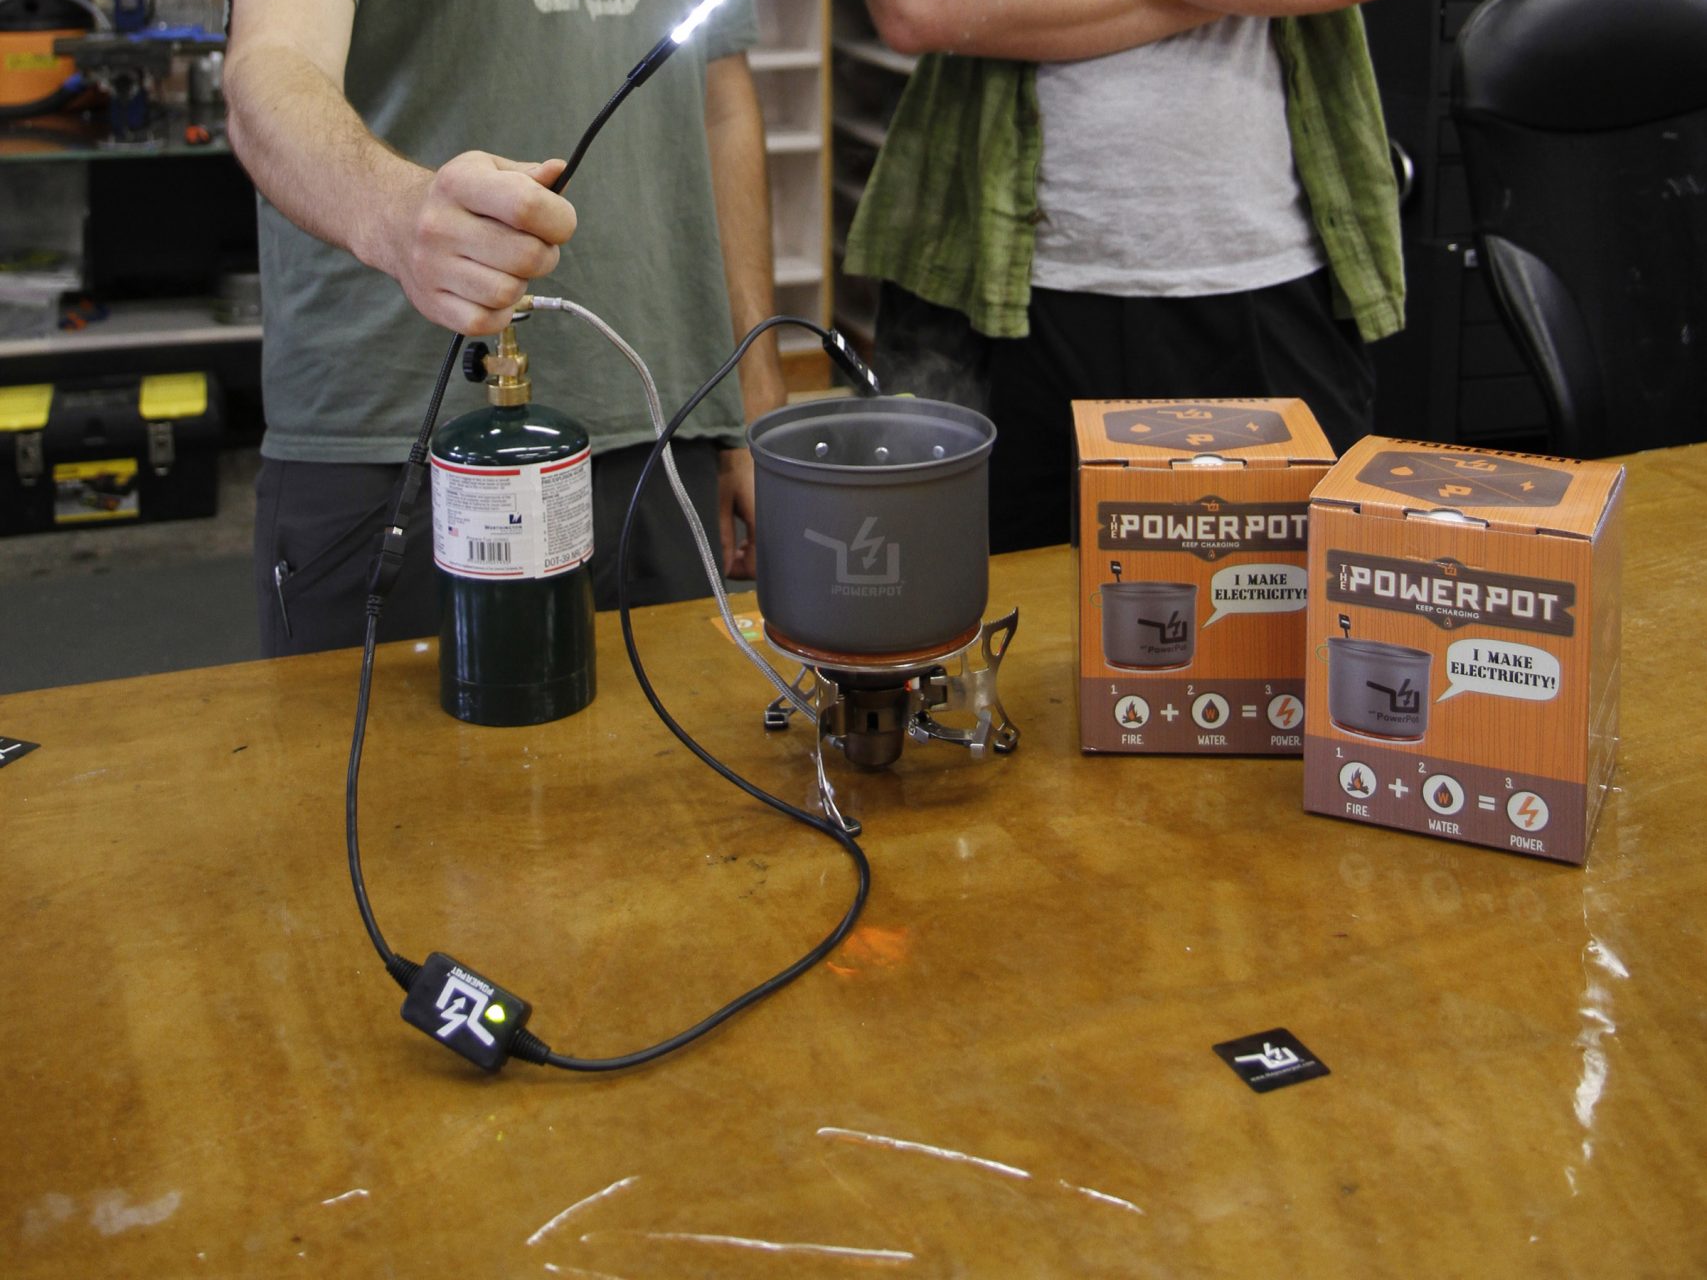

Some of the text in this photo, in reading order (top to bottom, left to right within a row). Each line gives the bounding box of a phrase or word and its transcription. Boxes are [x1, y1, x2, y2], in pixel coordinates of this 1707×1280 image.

[1110, 514, 1118, 540] THE
[1181, 541, 1240, 549] KEEP CHARGING
[1234, 573, 1287, 586] I MAKE
[1339, 564, 1347, 591] THE
[1214, 587, 1307, 601] ELECTRICITY!
[1415, 603, 1480, 619] KEEP CHARGING
[1473, 648, 1533, 670] I MAKE
[1450, 661, 1556, 690] ELECTRICITY!
[1121, 734, 1145, 745] FIRE.
[1345, 803, 1370, 818] FIRE.
[1428, 818, 1462, 836] WATER.
[1509, 835, 1546, 853] POWER.
